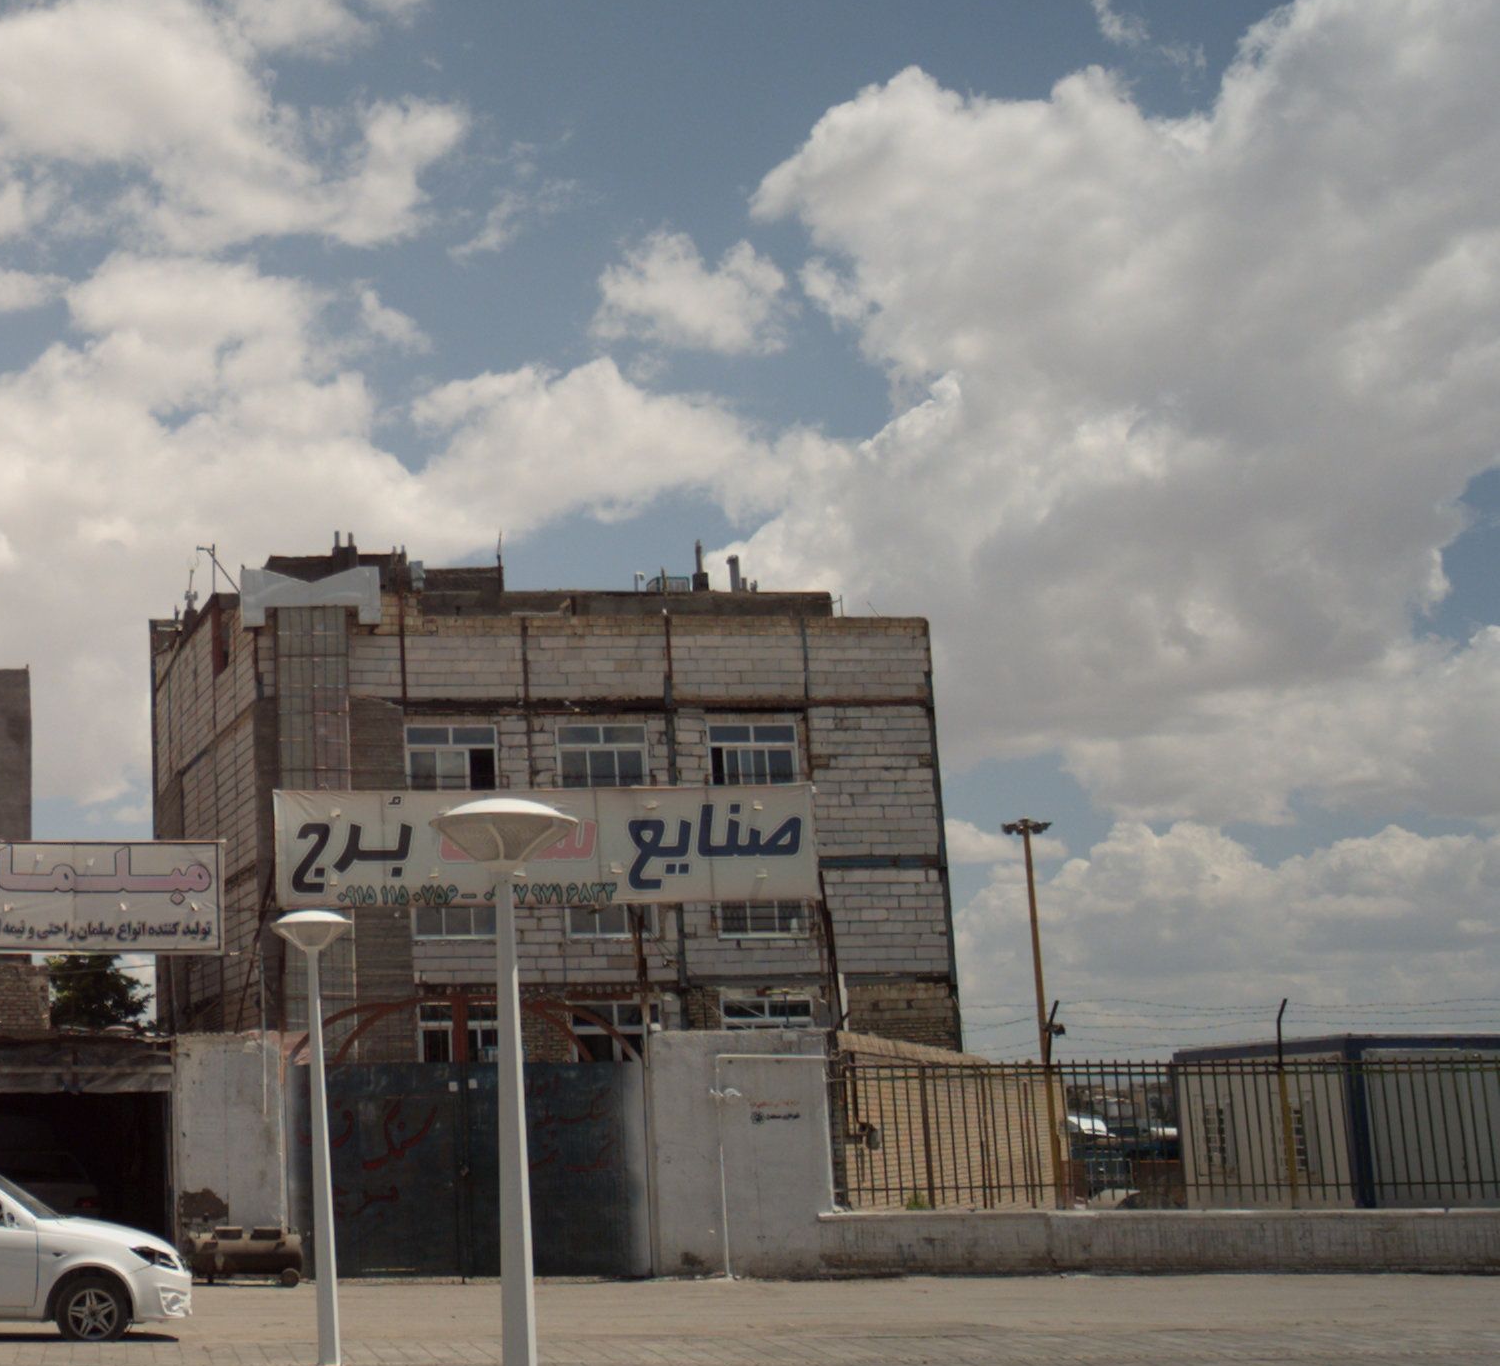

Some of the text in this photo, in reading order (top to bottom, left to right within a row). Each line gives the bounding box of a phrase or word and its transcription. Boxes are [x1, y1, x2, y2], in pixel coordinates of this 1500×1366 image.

[629, 803, 802, 890] صنایع
[337, 885, 377, 906] ۰۹۱۵
[380, 885, 410, 906] ۱۱۵
[412, 884, 460, 906] ۰۷۵۶
[2, 920, 25, 939] نیمه
[26, 926, 35, 939] و
[37, 922, 74, 941] راحتی
[77, 921, 115, 941] مبلمان
[116, 921, 146, 941] انواع
[148, 921, 180, 937] کننده
[181, 920, 212, 941] تولید
